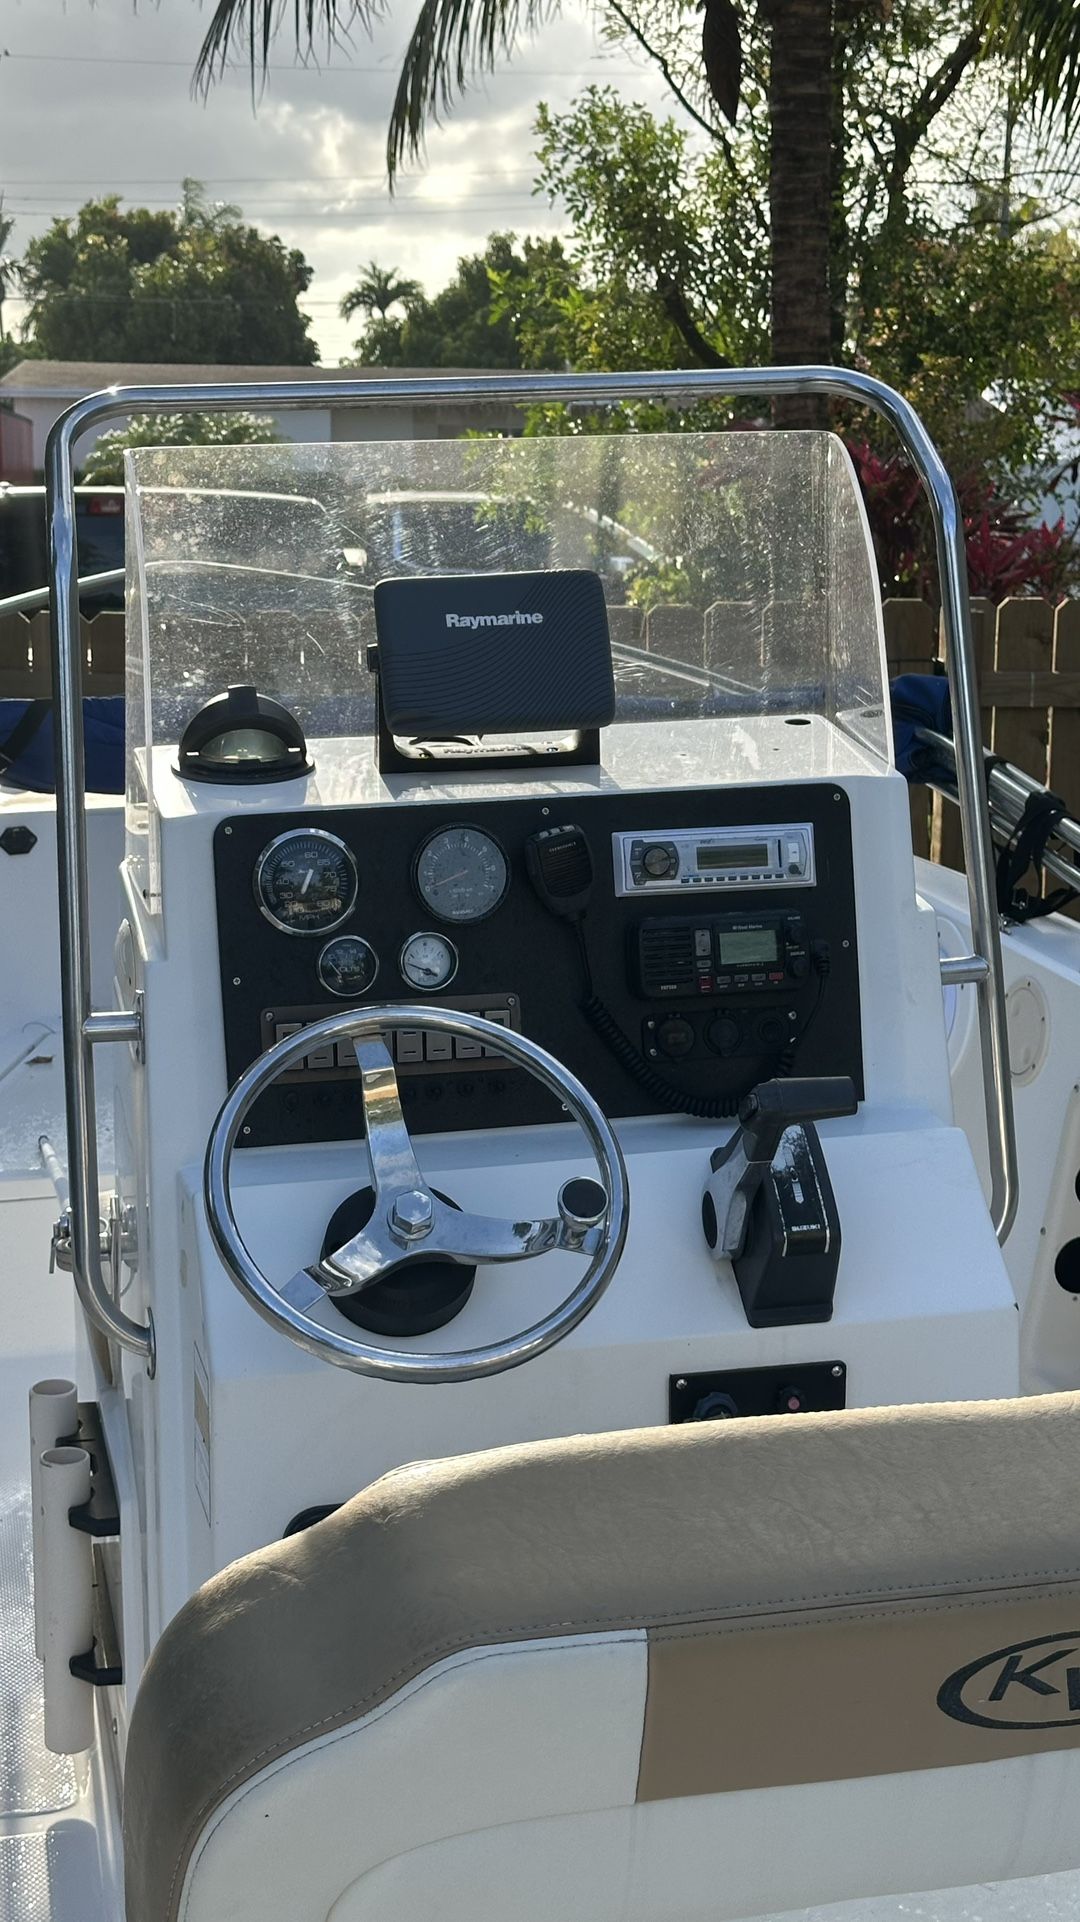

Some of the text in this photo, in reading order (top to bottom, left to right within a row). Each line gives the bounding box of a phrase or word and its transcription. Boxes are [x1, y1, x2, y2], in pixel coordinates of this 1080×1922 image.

[445, 610, 544, 630] Raymarine
[304, 851, 318, 859] 60
[791, 1223, 821, 1232] SUZUKI
[988, 1648, 1080, 1711] K
